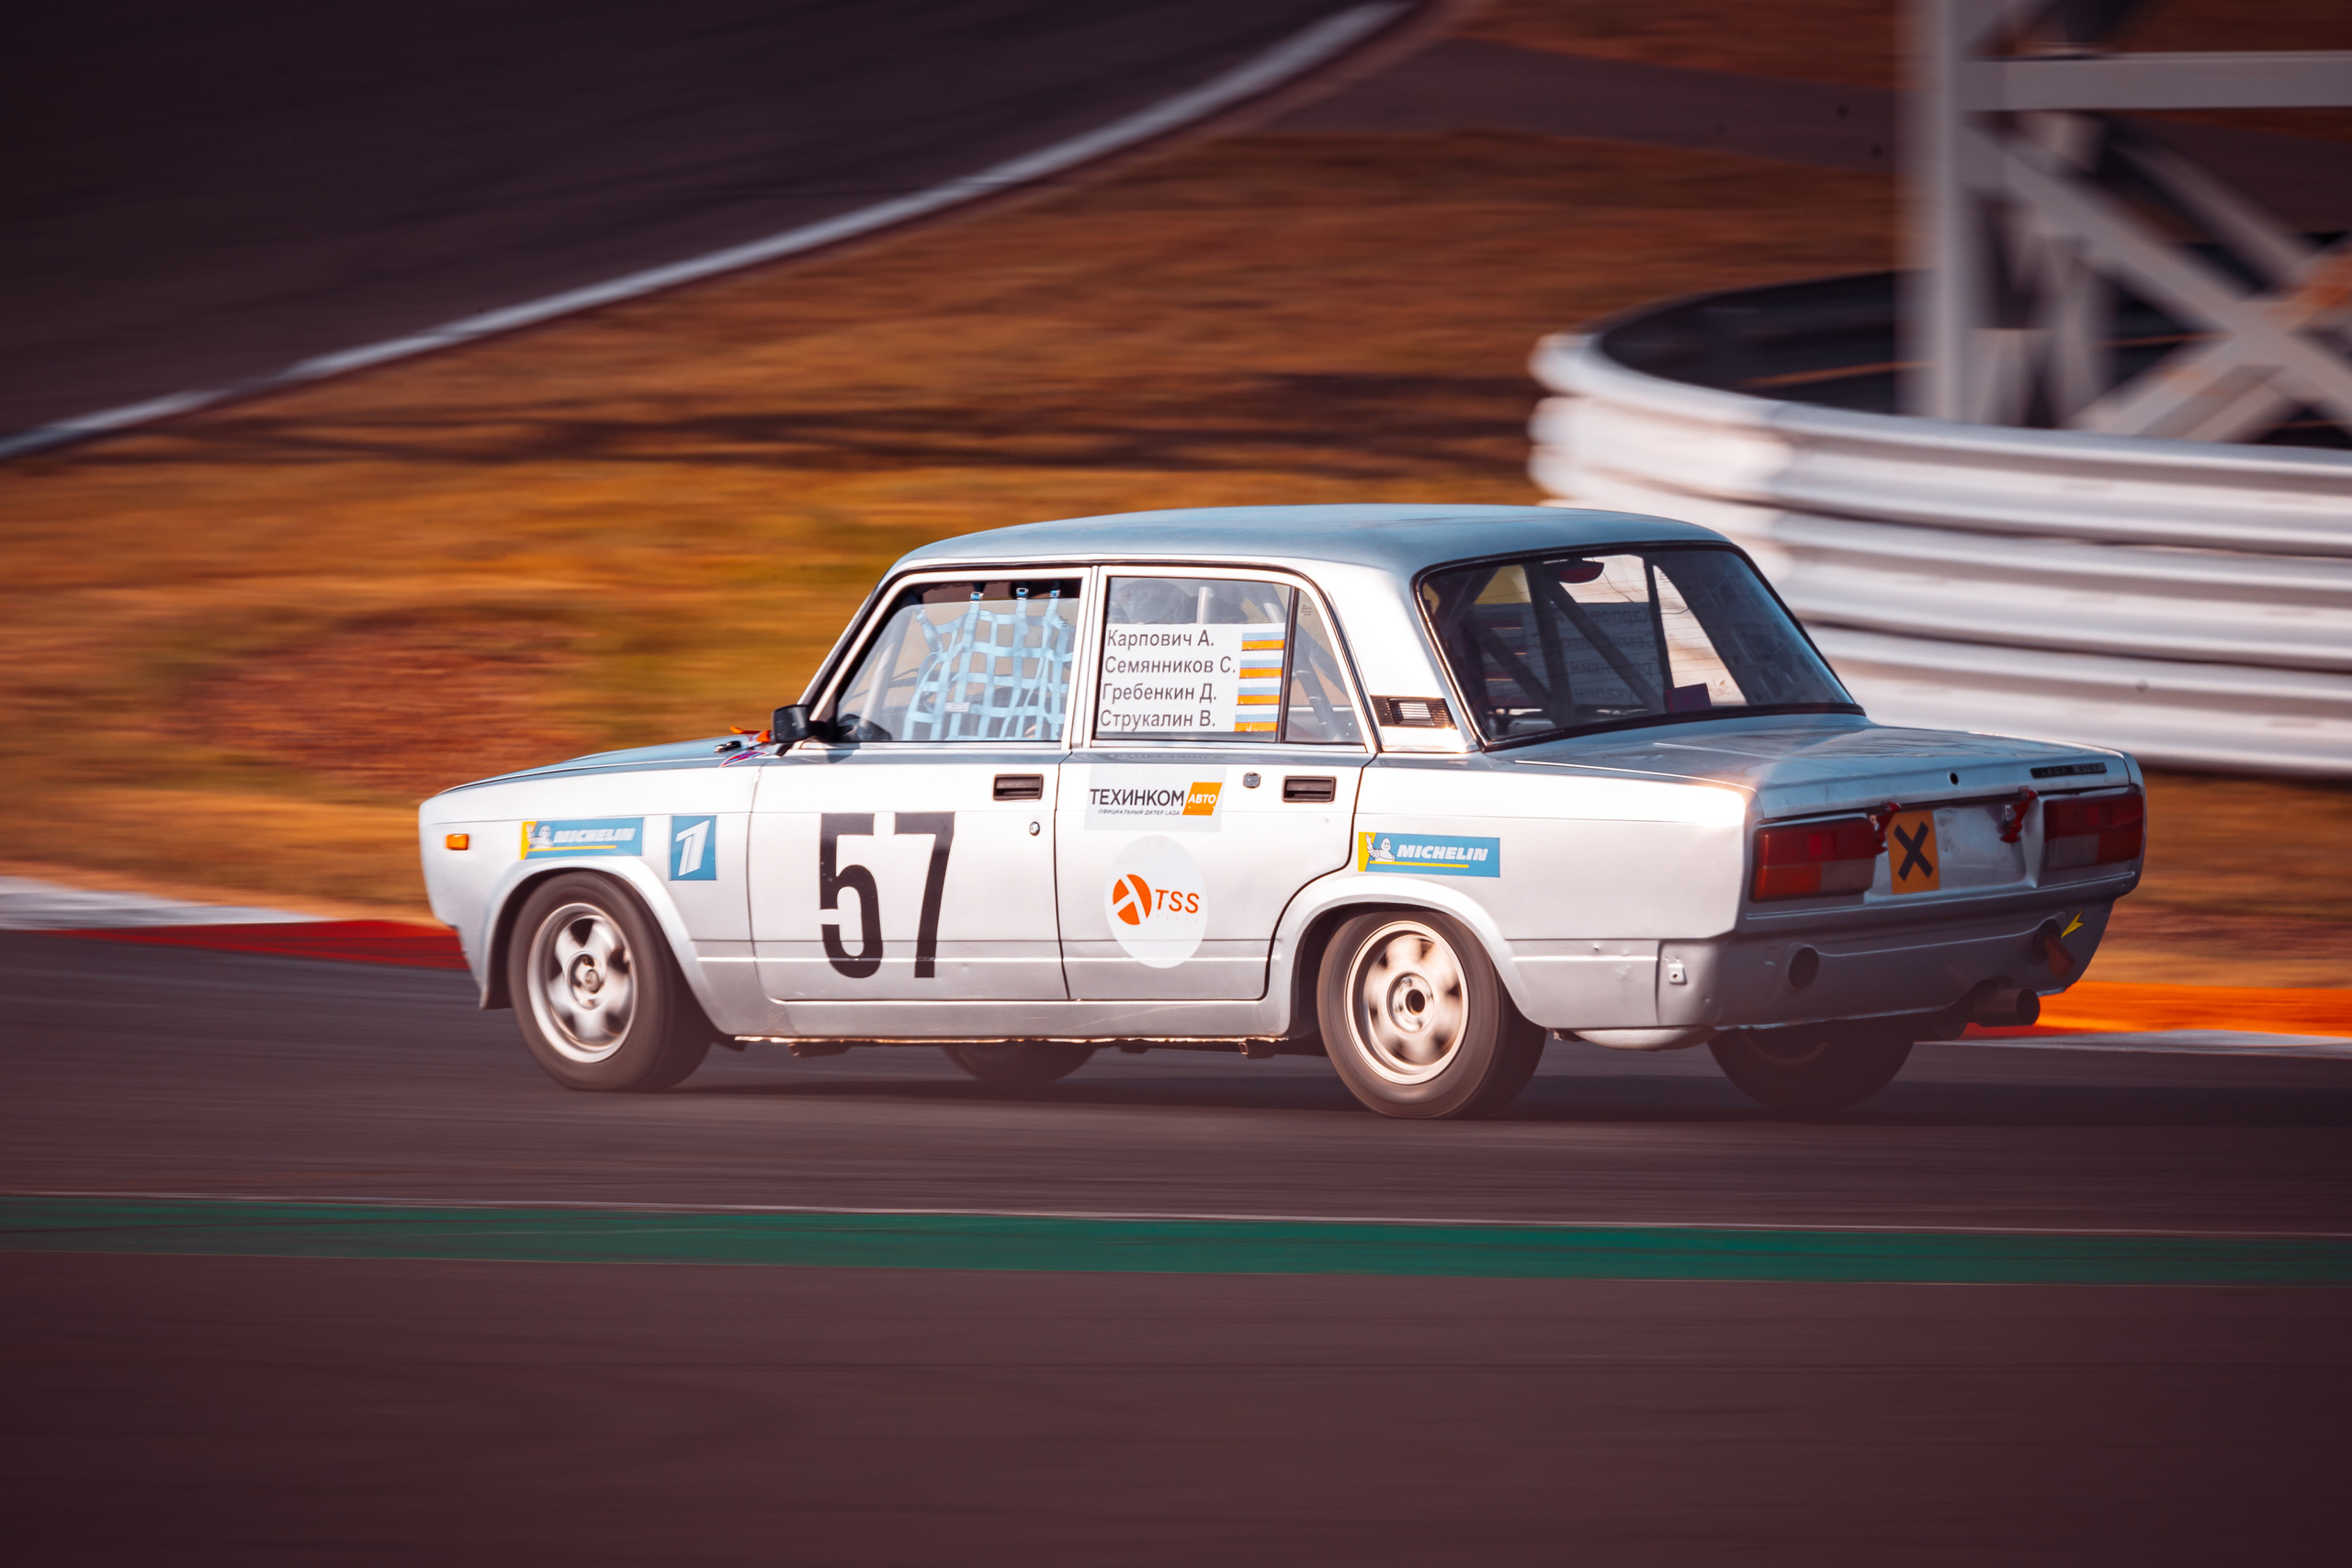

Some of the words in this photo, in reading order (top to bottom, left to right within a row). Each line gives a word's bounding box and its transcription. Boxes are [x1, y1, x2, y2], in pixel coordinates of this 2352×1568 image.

[1107, 629, 1193, 650] Карпович
[1197, 629, 1215, 647] А.
[1104, 656, 1214, 673] Семянников
[1219, 656, 1236, 673] С.
[1102, 682, 1194, 705] Гребенкин
[1199, 682, 1216, 704] Д.
[1100, 709, 1193, 732] Струкалин
[1199, 709, 1216, 727] В.
[1090, 789, 1185, 807] ТЕХИНКОМ
[1187, 794, 1216, 805] АВТО
[553, 828, 637, 843] MICHELIN
[675, 819, 711, 876] 1
[1396, 844, 1488, 862] MICHELIN
[819, 811, 956, 978] 57
[1155, 889, 1200, 914] TSS
